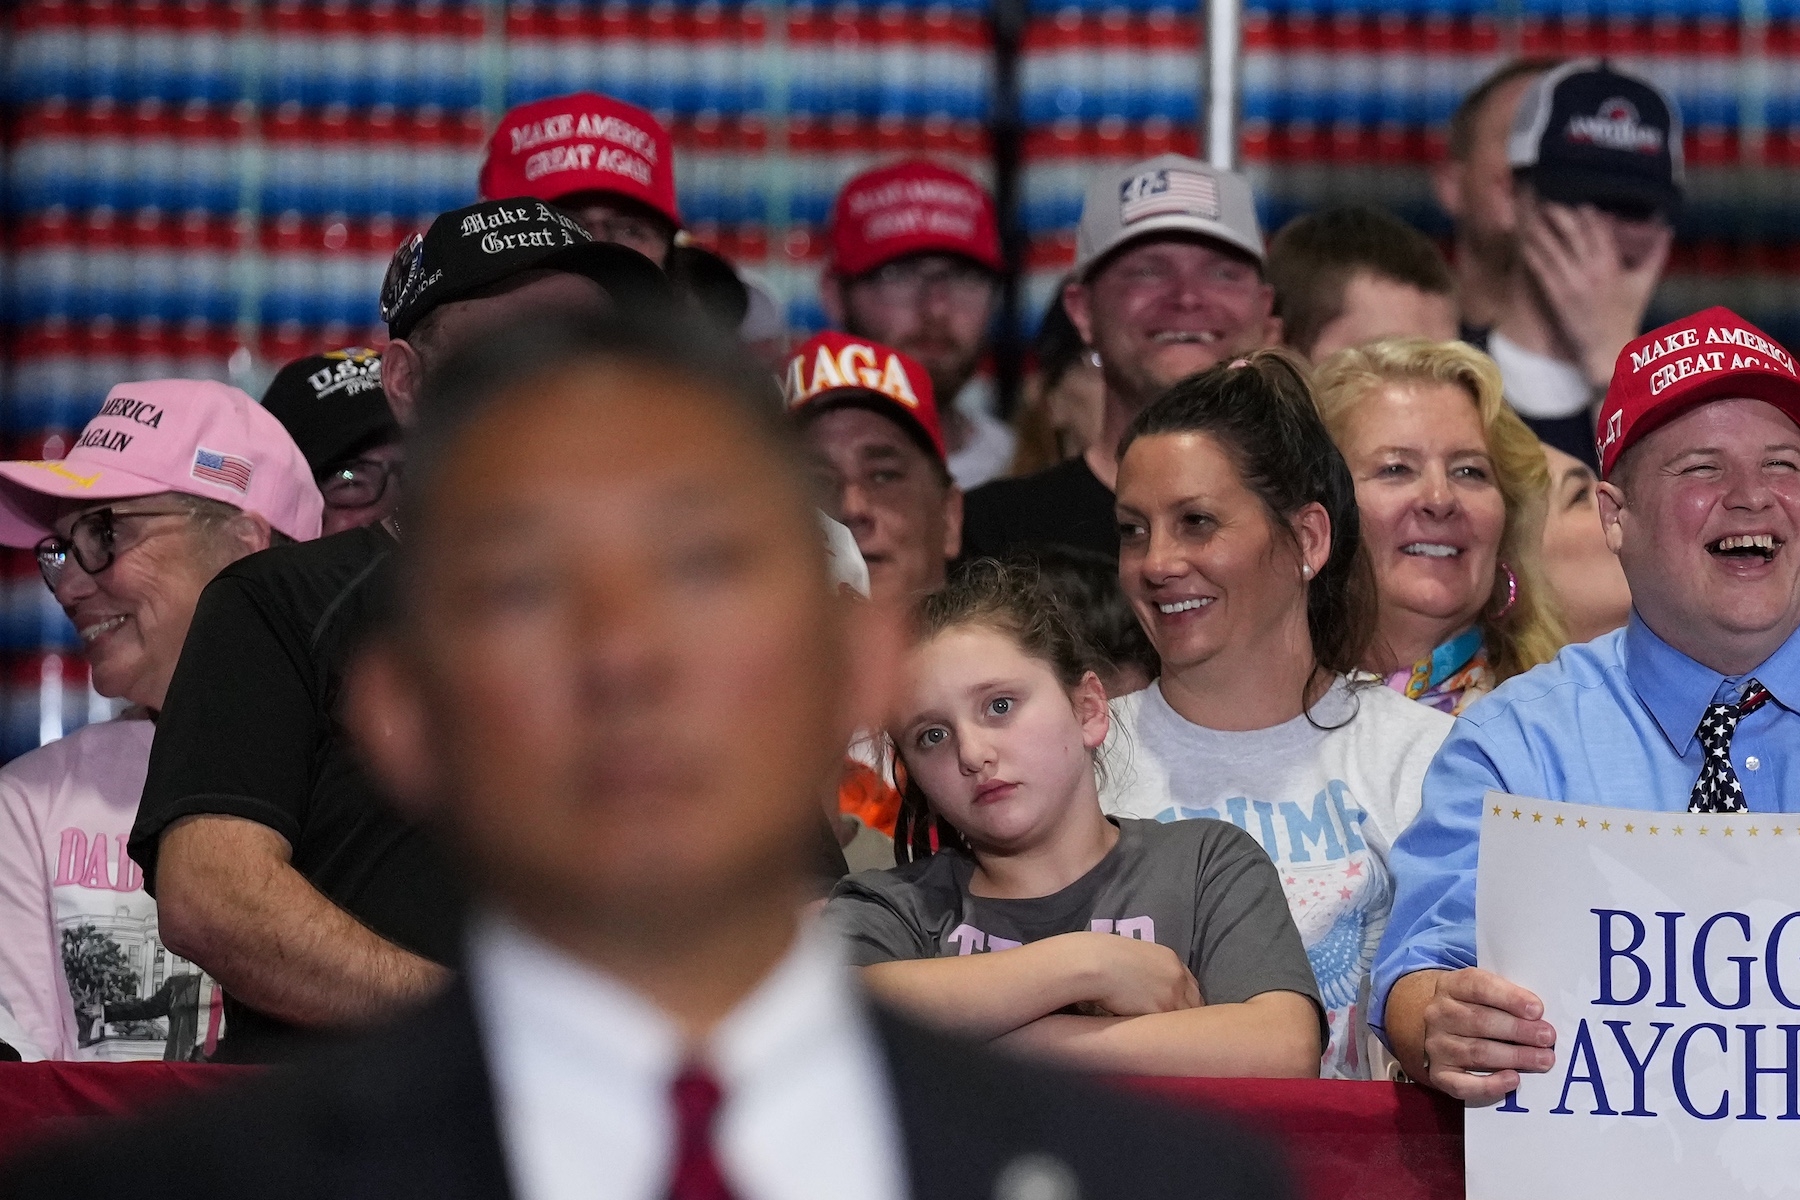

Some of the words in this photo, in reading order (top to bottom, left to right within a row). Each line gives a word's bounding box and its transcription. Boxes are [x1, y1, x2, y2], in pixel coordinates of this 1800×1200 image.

[461, 206, 530, 237] Make
[481, 227, 556, 254] Great
[1630, 328, 1699, 374] MAKE
[1705, 327, 1797, 377] AMERICA
[1650, 351, 1725, 395] GREAT
[774, 343, 919, 410] MAGA
[98, 397, 164, 429] MERICA
[76, 428, 133, 453] AGAIN
[1156, 779, 1368, 865] UMP
[54, 826, 144, 893] DAD
